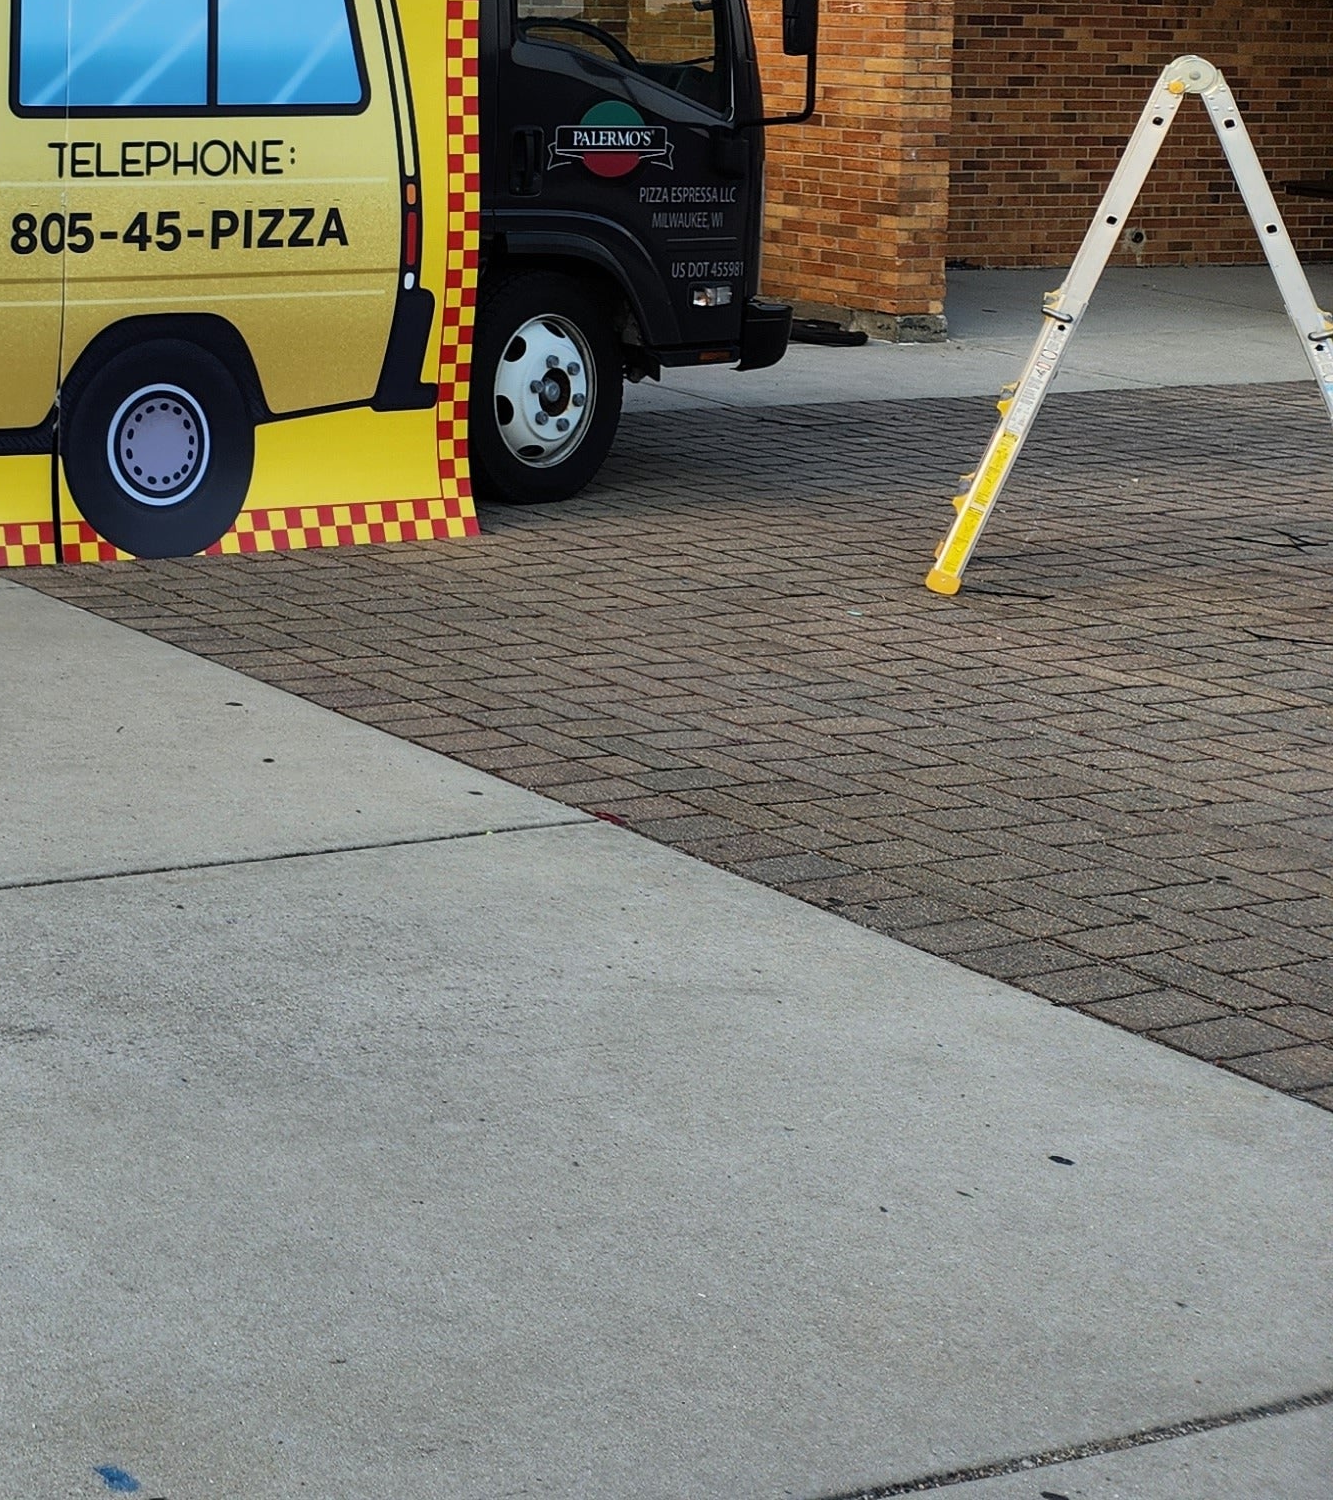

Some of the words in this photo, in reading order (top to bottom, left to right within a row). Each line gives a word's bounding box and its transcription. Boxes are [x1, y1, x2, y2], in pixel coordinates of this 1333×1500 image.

[572, 130, 652, 147] PALERMO'S
[47, 139, 296, 179] TELEPHONE:
[639, 187, 669, 203] PIZZA
[670, 186, 718, 203] ESPRESSA
[720, 187, 737, 203] LLC
[652, 211, 710, 230] MILWAUKEE,
[711, 211, 724, 228] WI
[10, 207, 350, 255] 805-45-PIZZA
[671, 262, 686, 278] US
[688, 262, 710, 278] DOT
